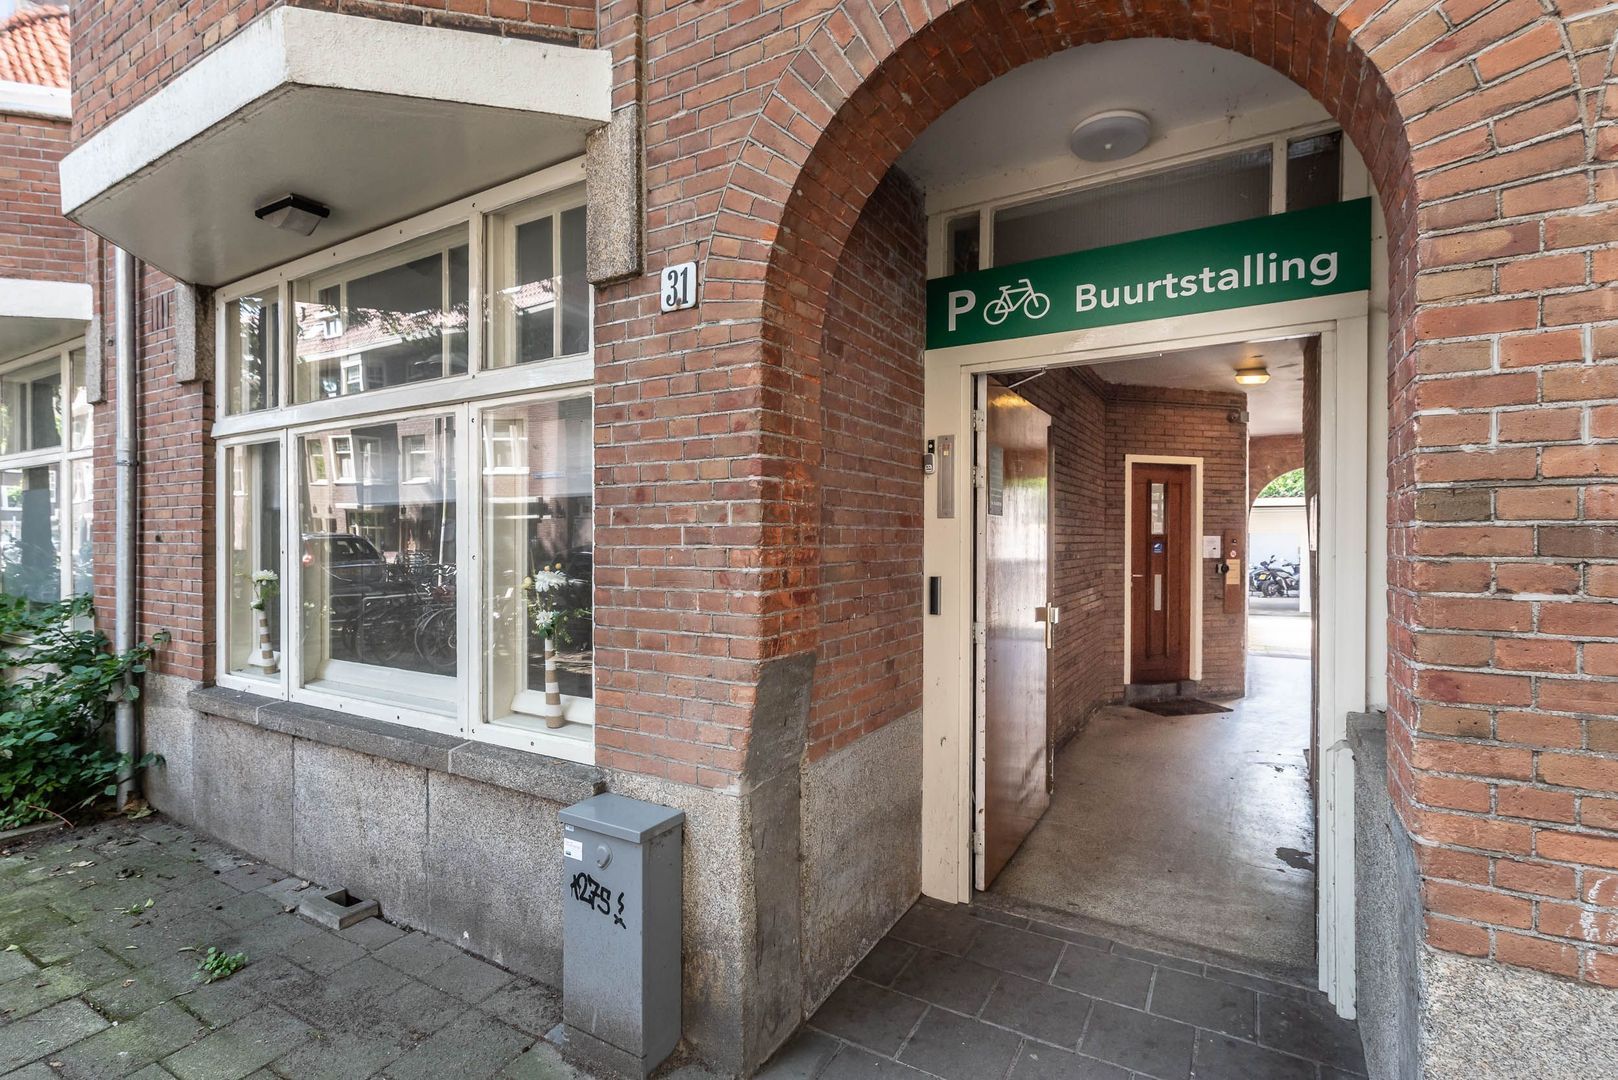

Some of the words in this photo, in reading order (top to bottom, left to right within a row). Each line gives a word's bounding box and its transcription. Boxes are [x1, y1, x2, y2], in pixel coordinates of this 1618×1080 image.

[666, 266, 689, 307] 31
[947, 289, 976, 332] P
[1075, 251, 1338, 313] Buurtstalling
